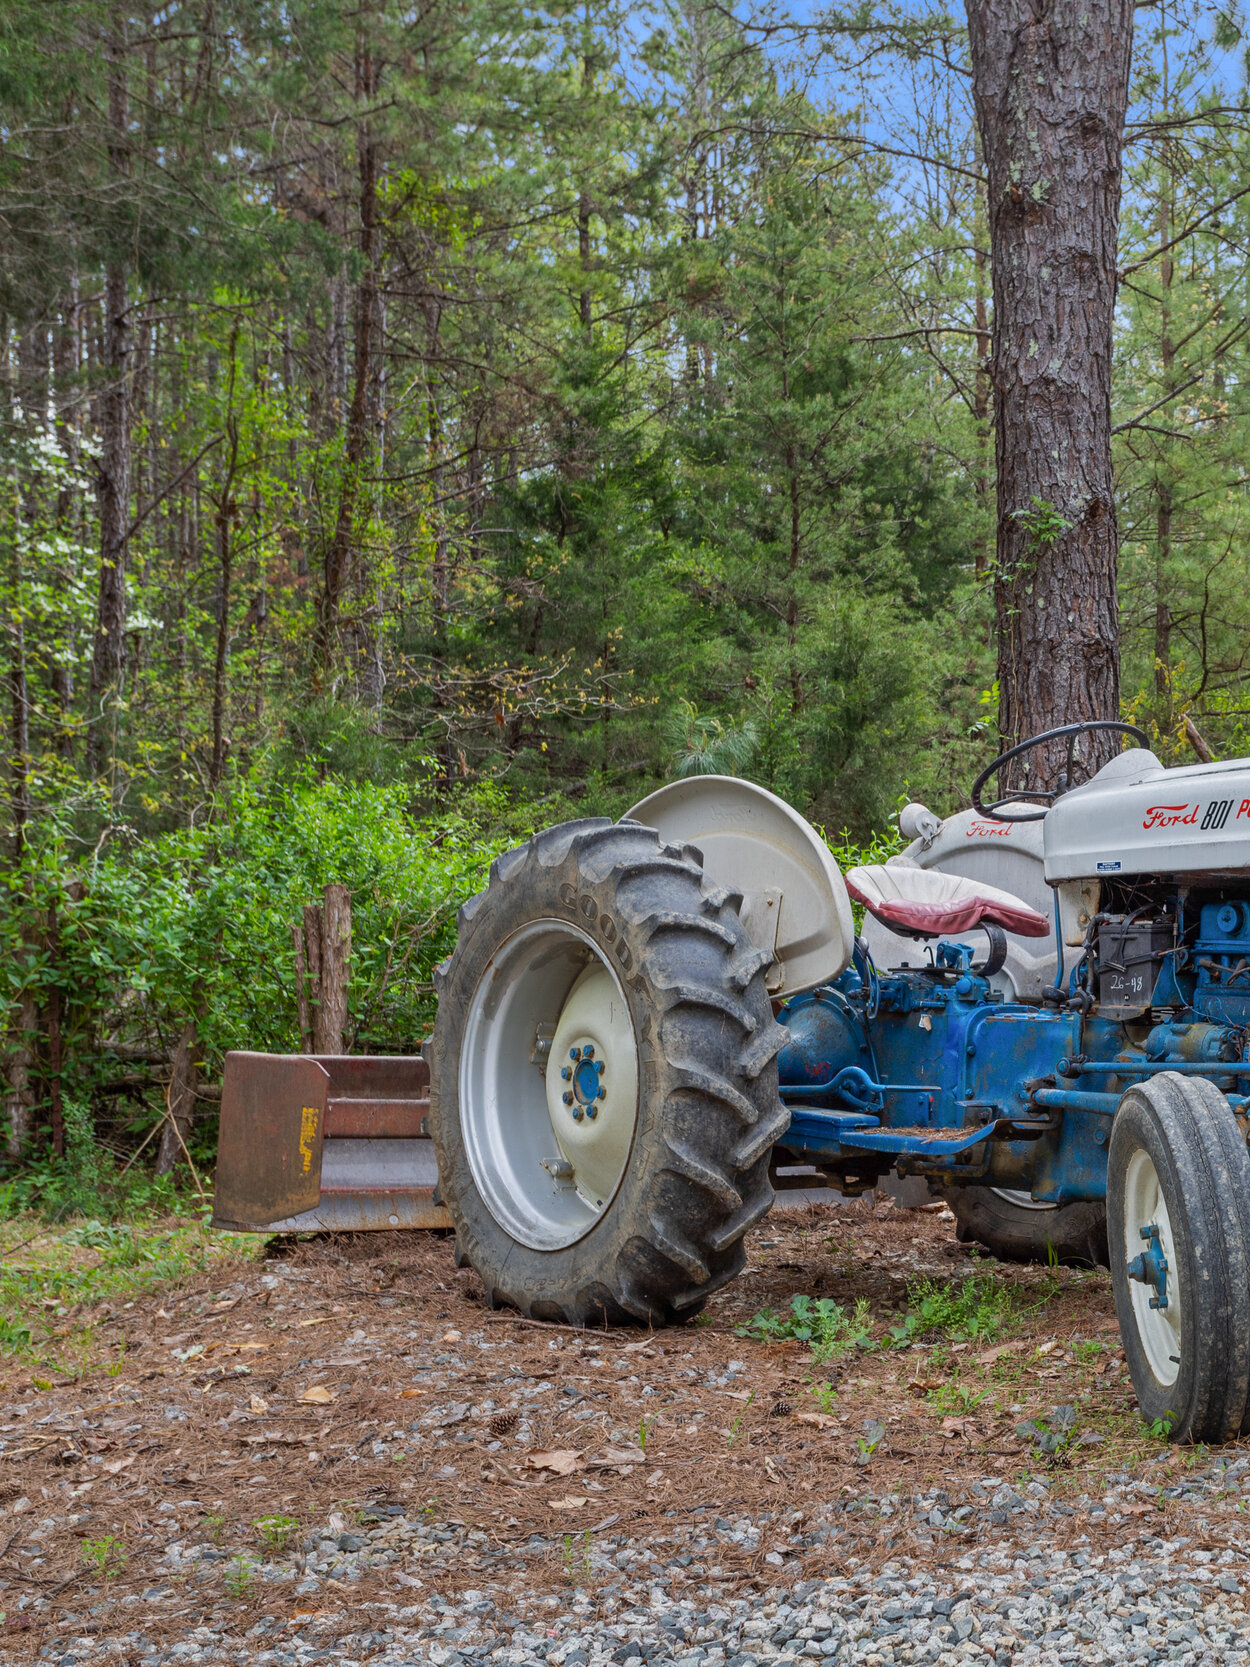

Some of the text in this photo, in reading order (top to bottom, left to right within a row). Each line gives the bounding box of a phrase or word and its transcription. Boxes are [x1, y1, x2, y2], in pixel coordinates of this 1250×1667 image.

[1142, 803, 1200, 830] Ford
[1200, 799, 1235, 830] 801
[966, 820, 1013, 837] Ford
[1109, 974, 1144, 993] 26-48
